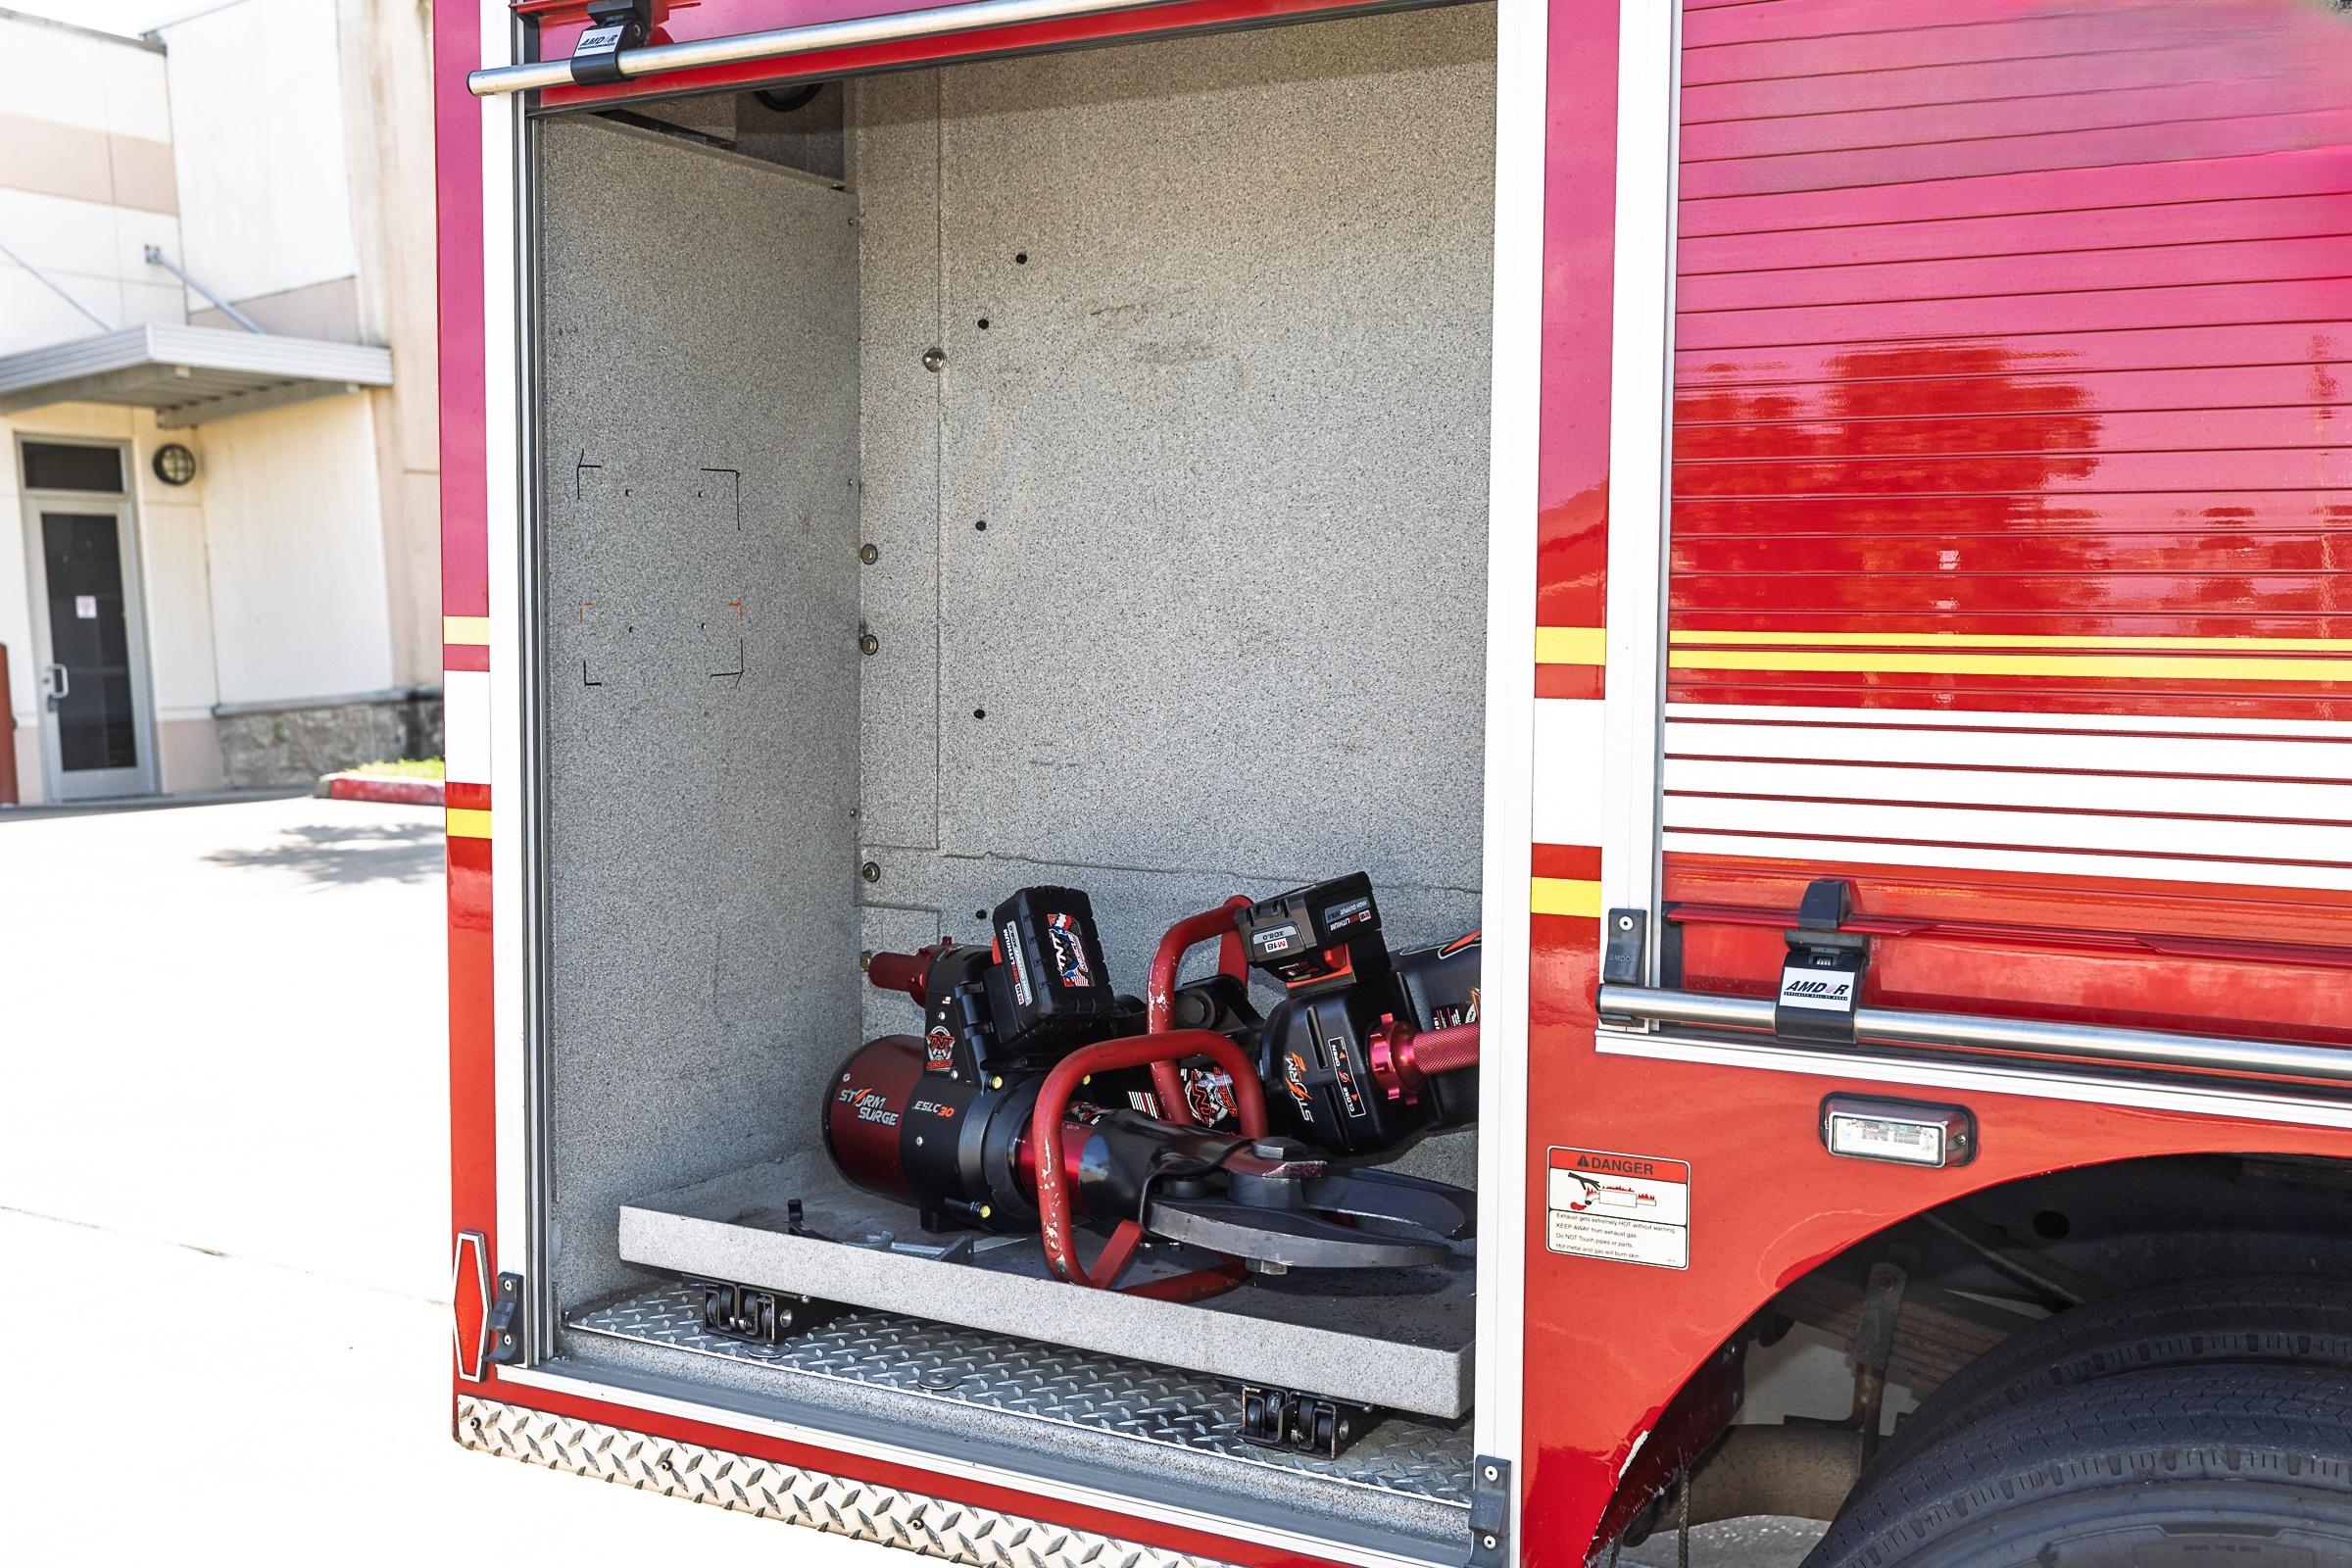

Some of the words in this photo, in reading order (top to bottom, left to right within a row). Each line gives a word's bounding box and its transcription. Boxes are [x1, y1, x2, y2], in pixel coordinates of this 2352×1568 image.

[1262, 930, 1285, 941] XC8.0
[1266, 939, 1287, 952] M18
[1049, 929, 1066, 975] TNT
[926, 1034, 956, 1054] TNT
[1331, 1044, 1341, 1066] OPEN
[839, 1088, 886, 1109] STORM
[1191, 1069, 1217, 1125] TNT
[1285, 1056, 1315, 1123] STORM
[1343, 1087, 1355, 1112] CLOSE
[858, 1106, 900, 1126] SURGE
[912, 1101, 955, 1117] ESLC30
[1592, 1157, 1653, 1175] DANGER
[1592, 1217, 1617, 1226] extremely
